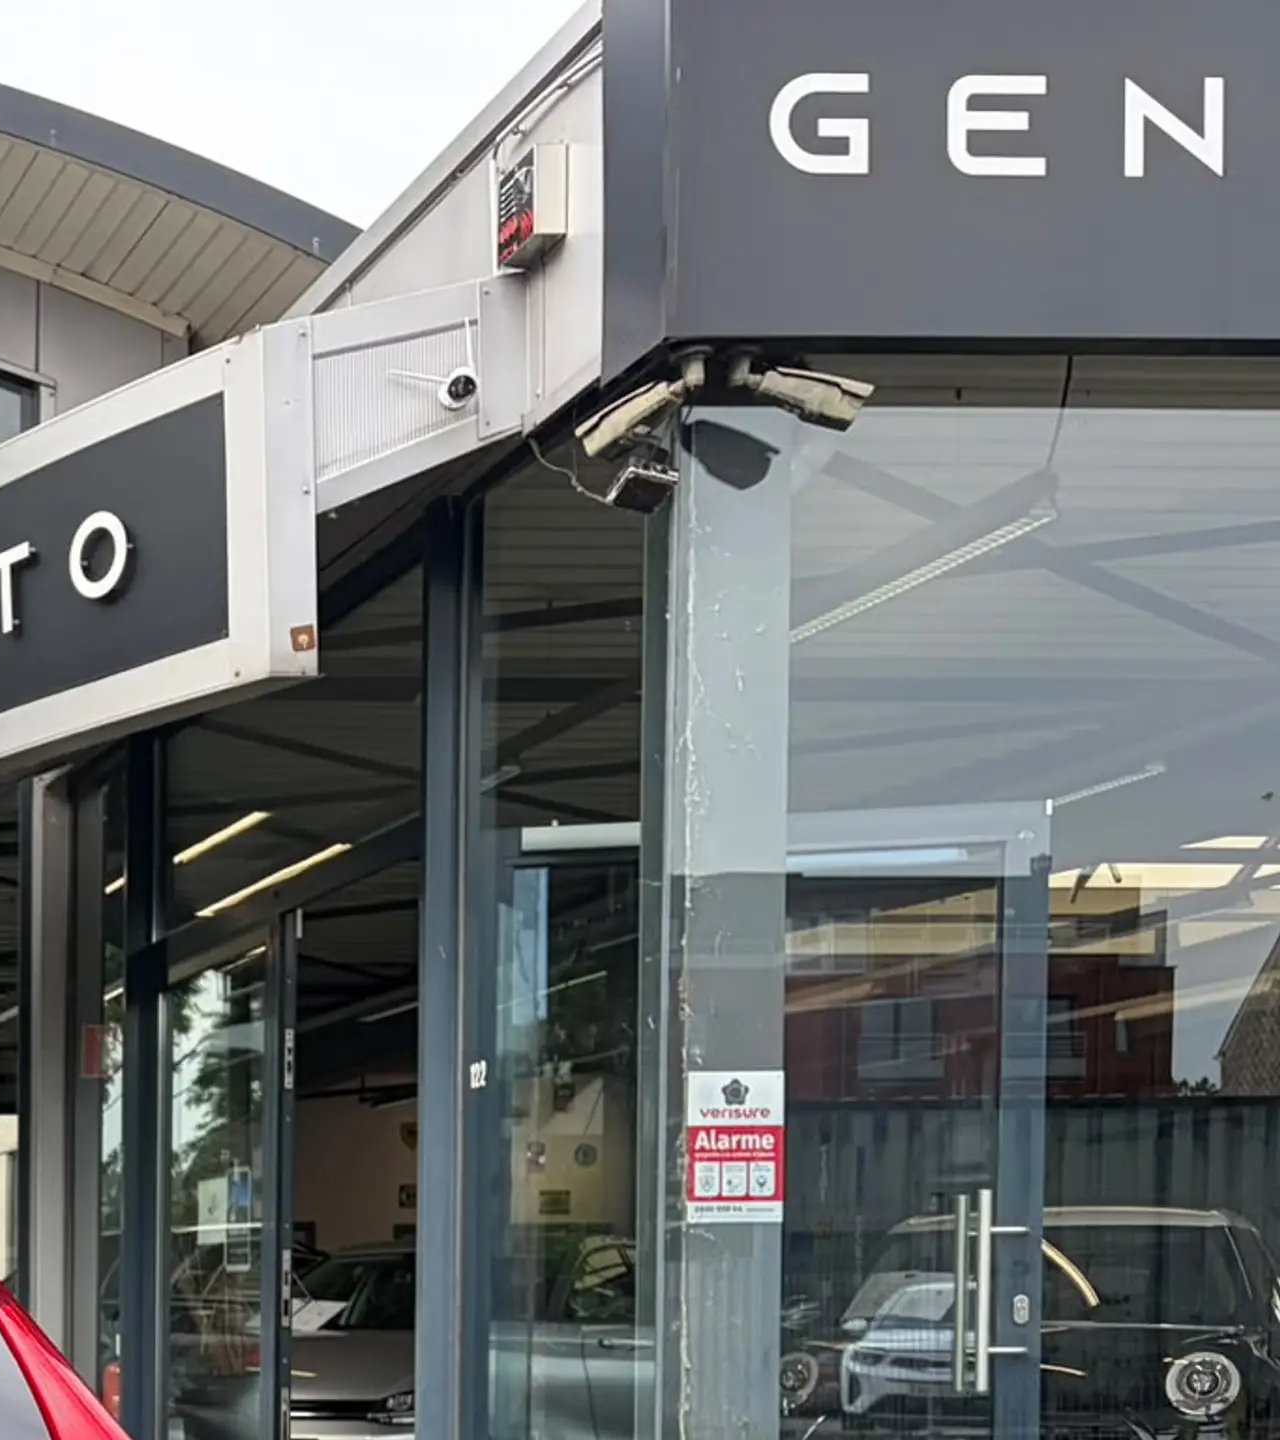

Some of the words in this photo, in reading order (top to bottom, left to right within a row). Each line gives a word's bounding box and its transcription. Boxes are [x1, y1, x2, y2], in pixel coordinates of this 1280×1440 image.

[768, 71, 1226, 178] GEN
[700, 1107, 771, 1119] verisure
[694, 1128, 776, 1151] Alarme
